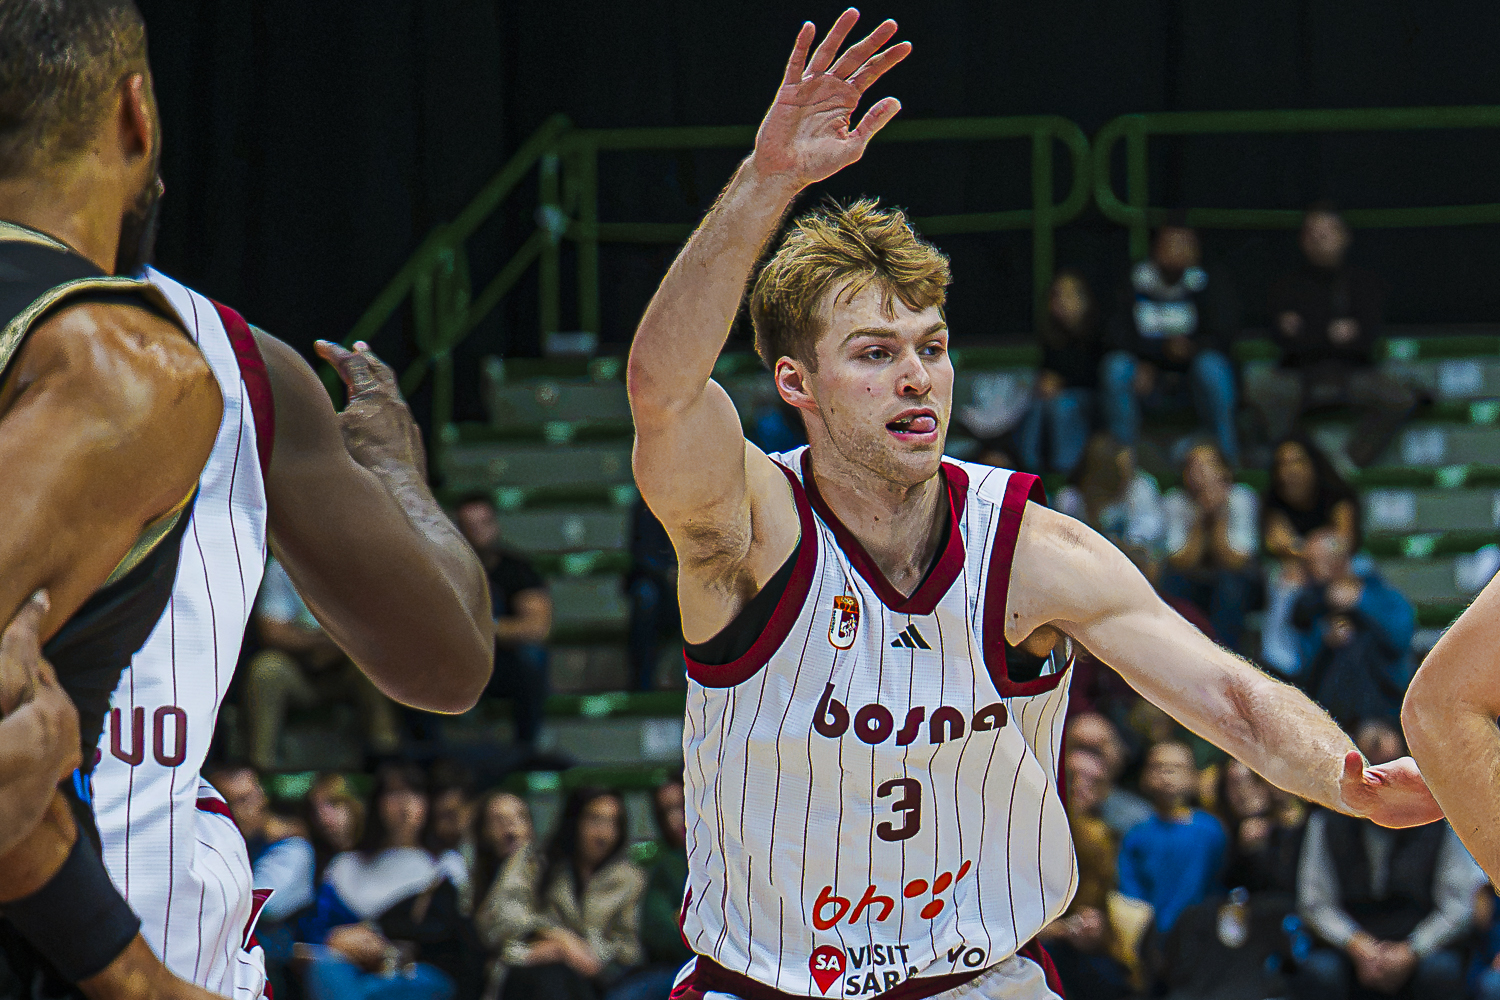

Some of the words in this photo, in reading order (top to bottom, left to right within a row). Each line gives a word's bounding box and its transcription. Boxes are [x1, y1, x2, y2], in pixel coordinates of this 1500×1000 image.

[812, 683, 1008, 746] bosna
[876, 777, 922, 843] 3
[814, 954, 841, 972] SA
[847, 943, 909, 969] VISIT
